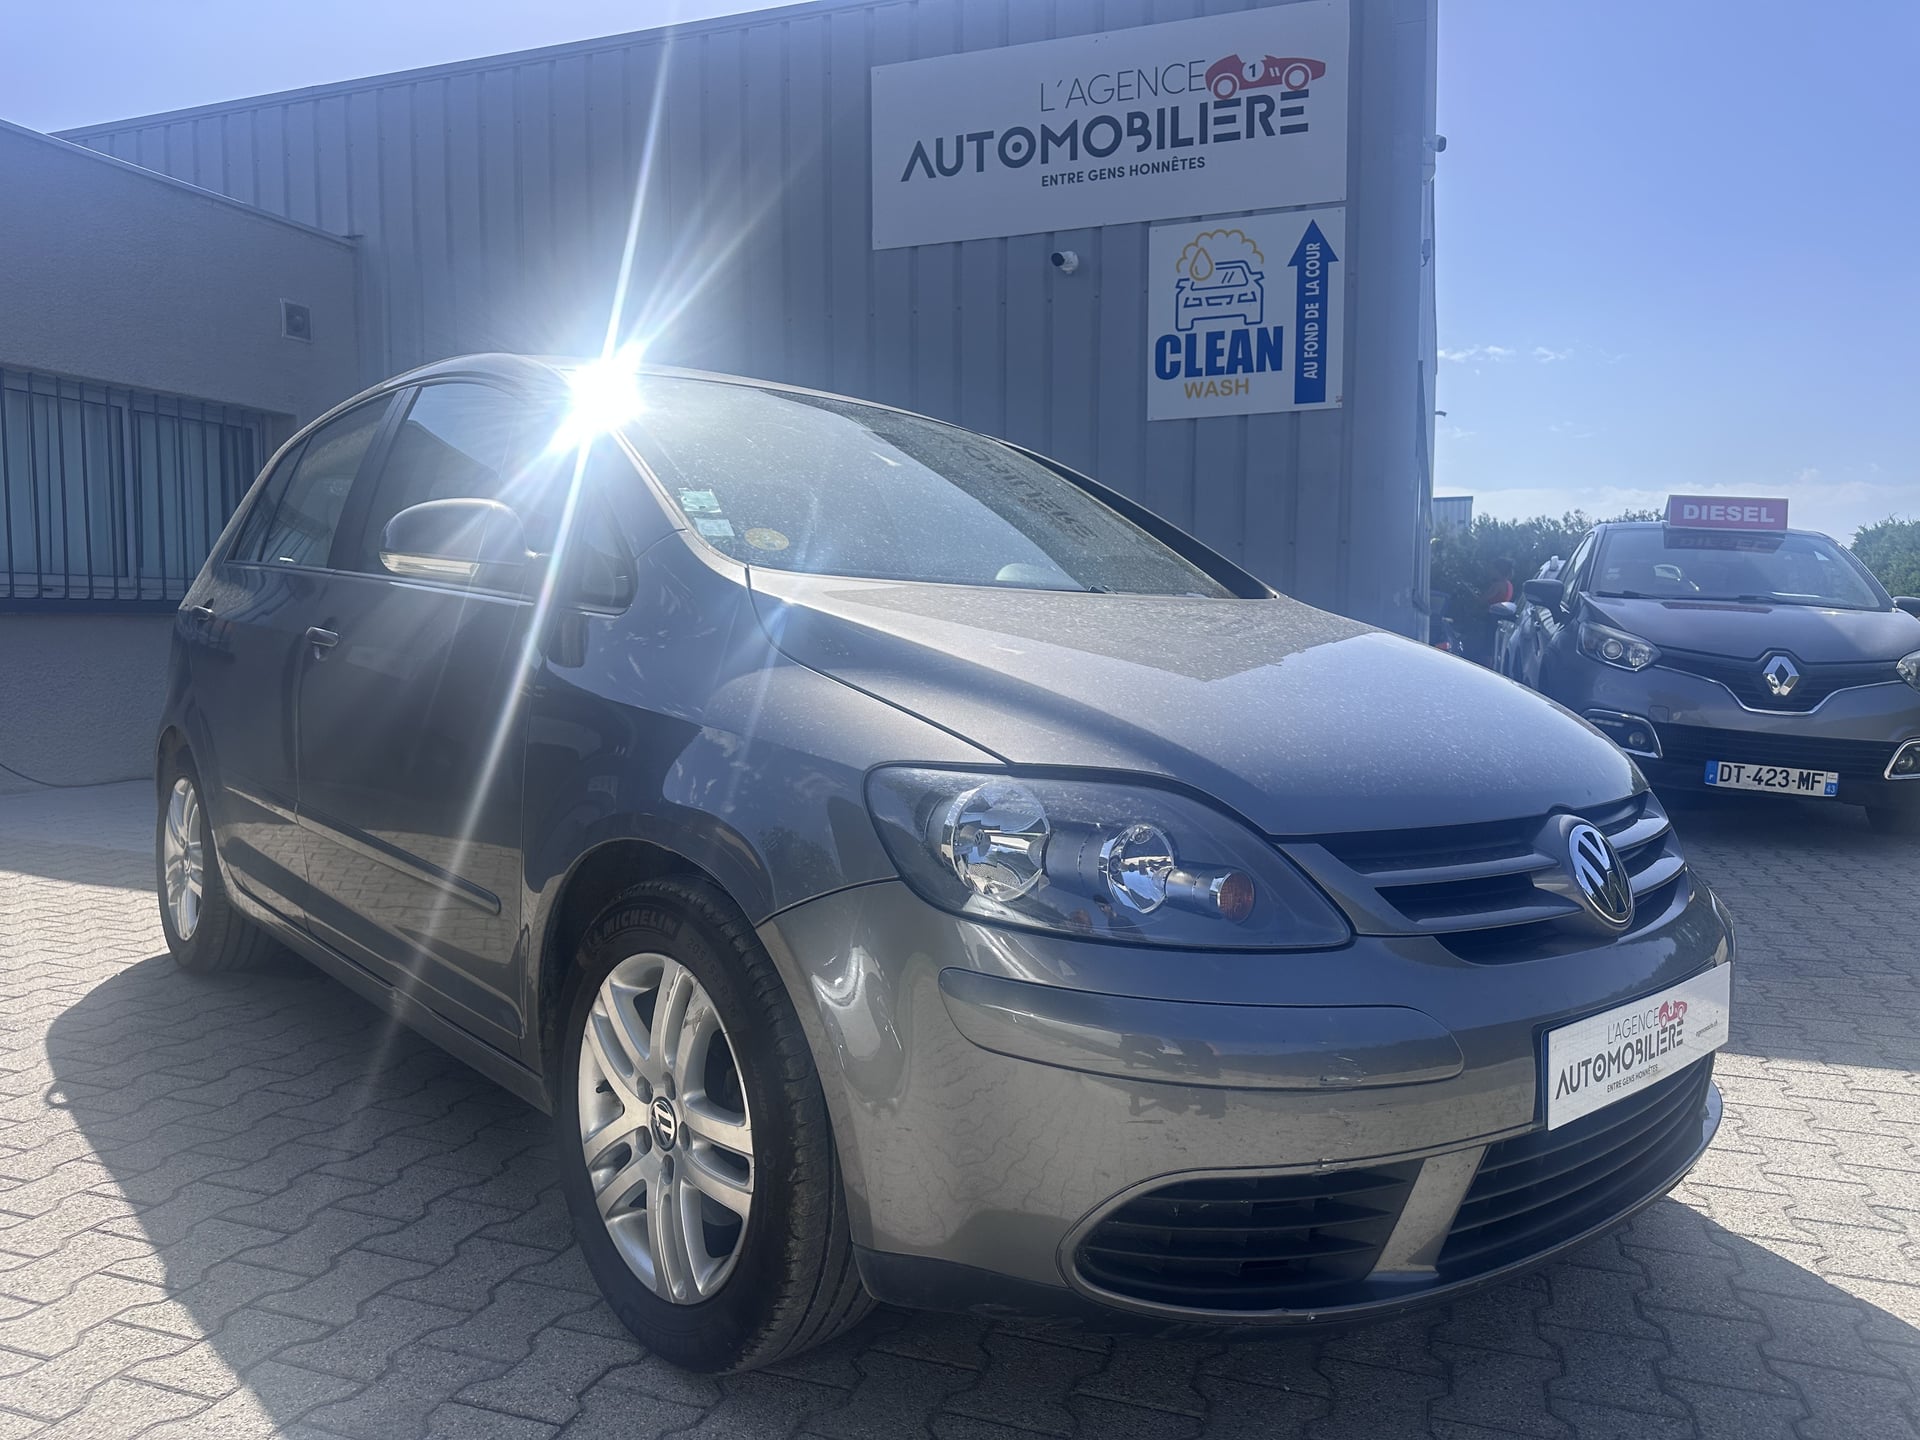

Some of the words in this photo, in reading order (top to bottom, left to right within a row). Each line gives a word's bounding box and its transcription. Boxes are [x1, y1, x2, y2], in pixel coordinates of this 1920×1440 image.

[1248, 63, 1257, 78] 1
[1040, 59, 1206, 112] L'AGENCE
[1041, 170, 1084, 188] ENTRE
[1088, 166, 1125, 182] GENS
[1129, 156, 1206, 178] HONNÊTES
[1305, 242, 1321, 278] COUR
[1305, 280, 1320, 296] LA
[1304, 302, 1320, 319] DE
[1154, 325, 1284, 381] CLEAN
[1304, 324, 1320, 359] FOND
[1303, 360, 1319, 379] AU
[1183, 378, 1250, 400] WASH
[1683, 503, 1775, 523] DIESEL
[1719, 764, 1824, 791] DT-423-MF
[1825, 784, 1836, 794] 43
[602, 908, 677, 938] MICHELIN
[1607, 1006, 1660, 1045] L'AGENCE
[1606, 1081, 1622, 1094] ENTRE
[1622, 1075, 1635, 1087] GENS
